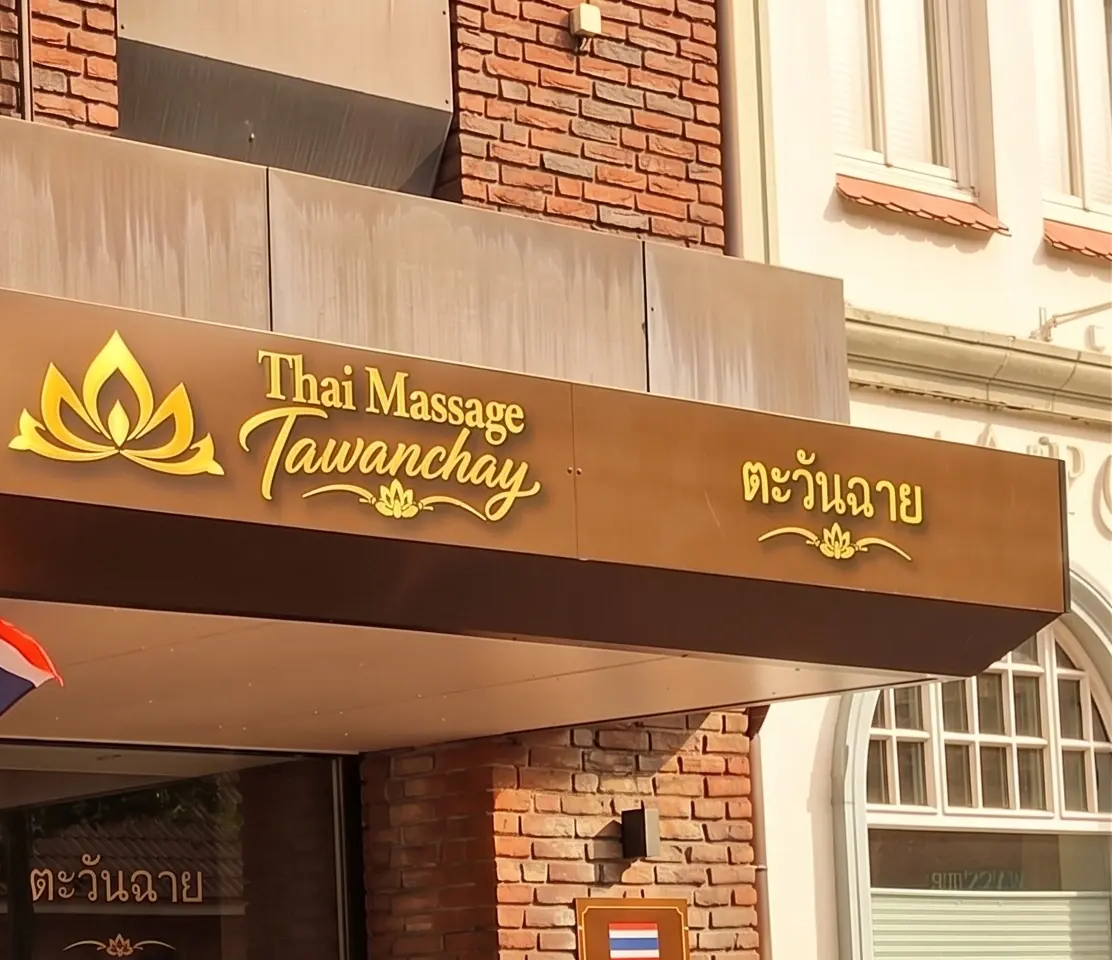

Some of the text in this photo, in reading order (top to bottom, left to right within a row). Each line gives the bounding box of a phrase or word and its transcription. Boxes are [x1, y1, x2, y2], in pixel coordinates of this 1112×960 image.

[258, 349, 526, 446] Thai Massage
[238, 406, 542, 523] Tawanchay
[741, 448, 924, 525] ตะวันฉาย
[29, 853, 204, 903] ตะวันฉาย
